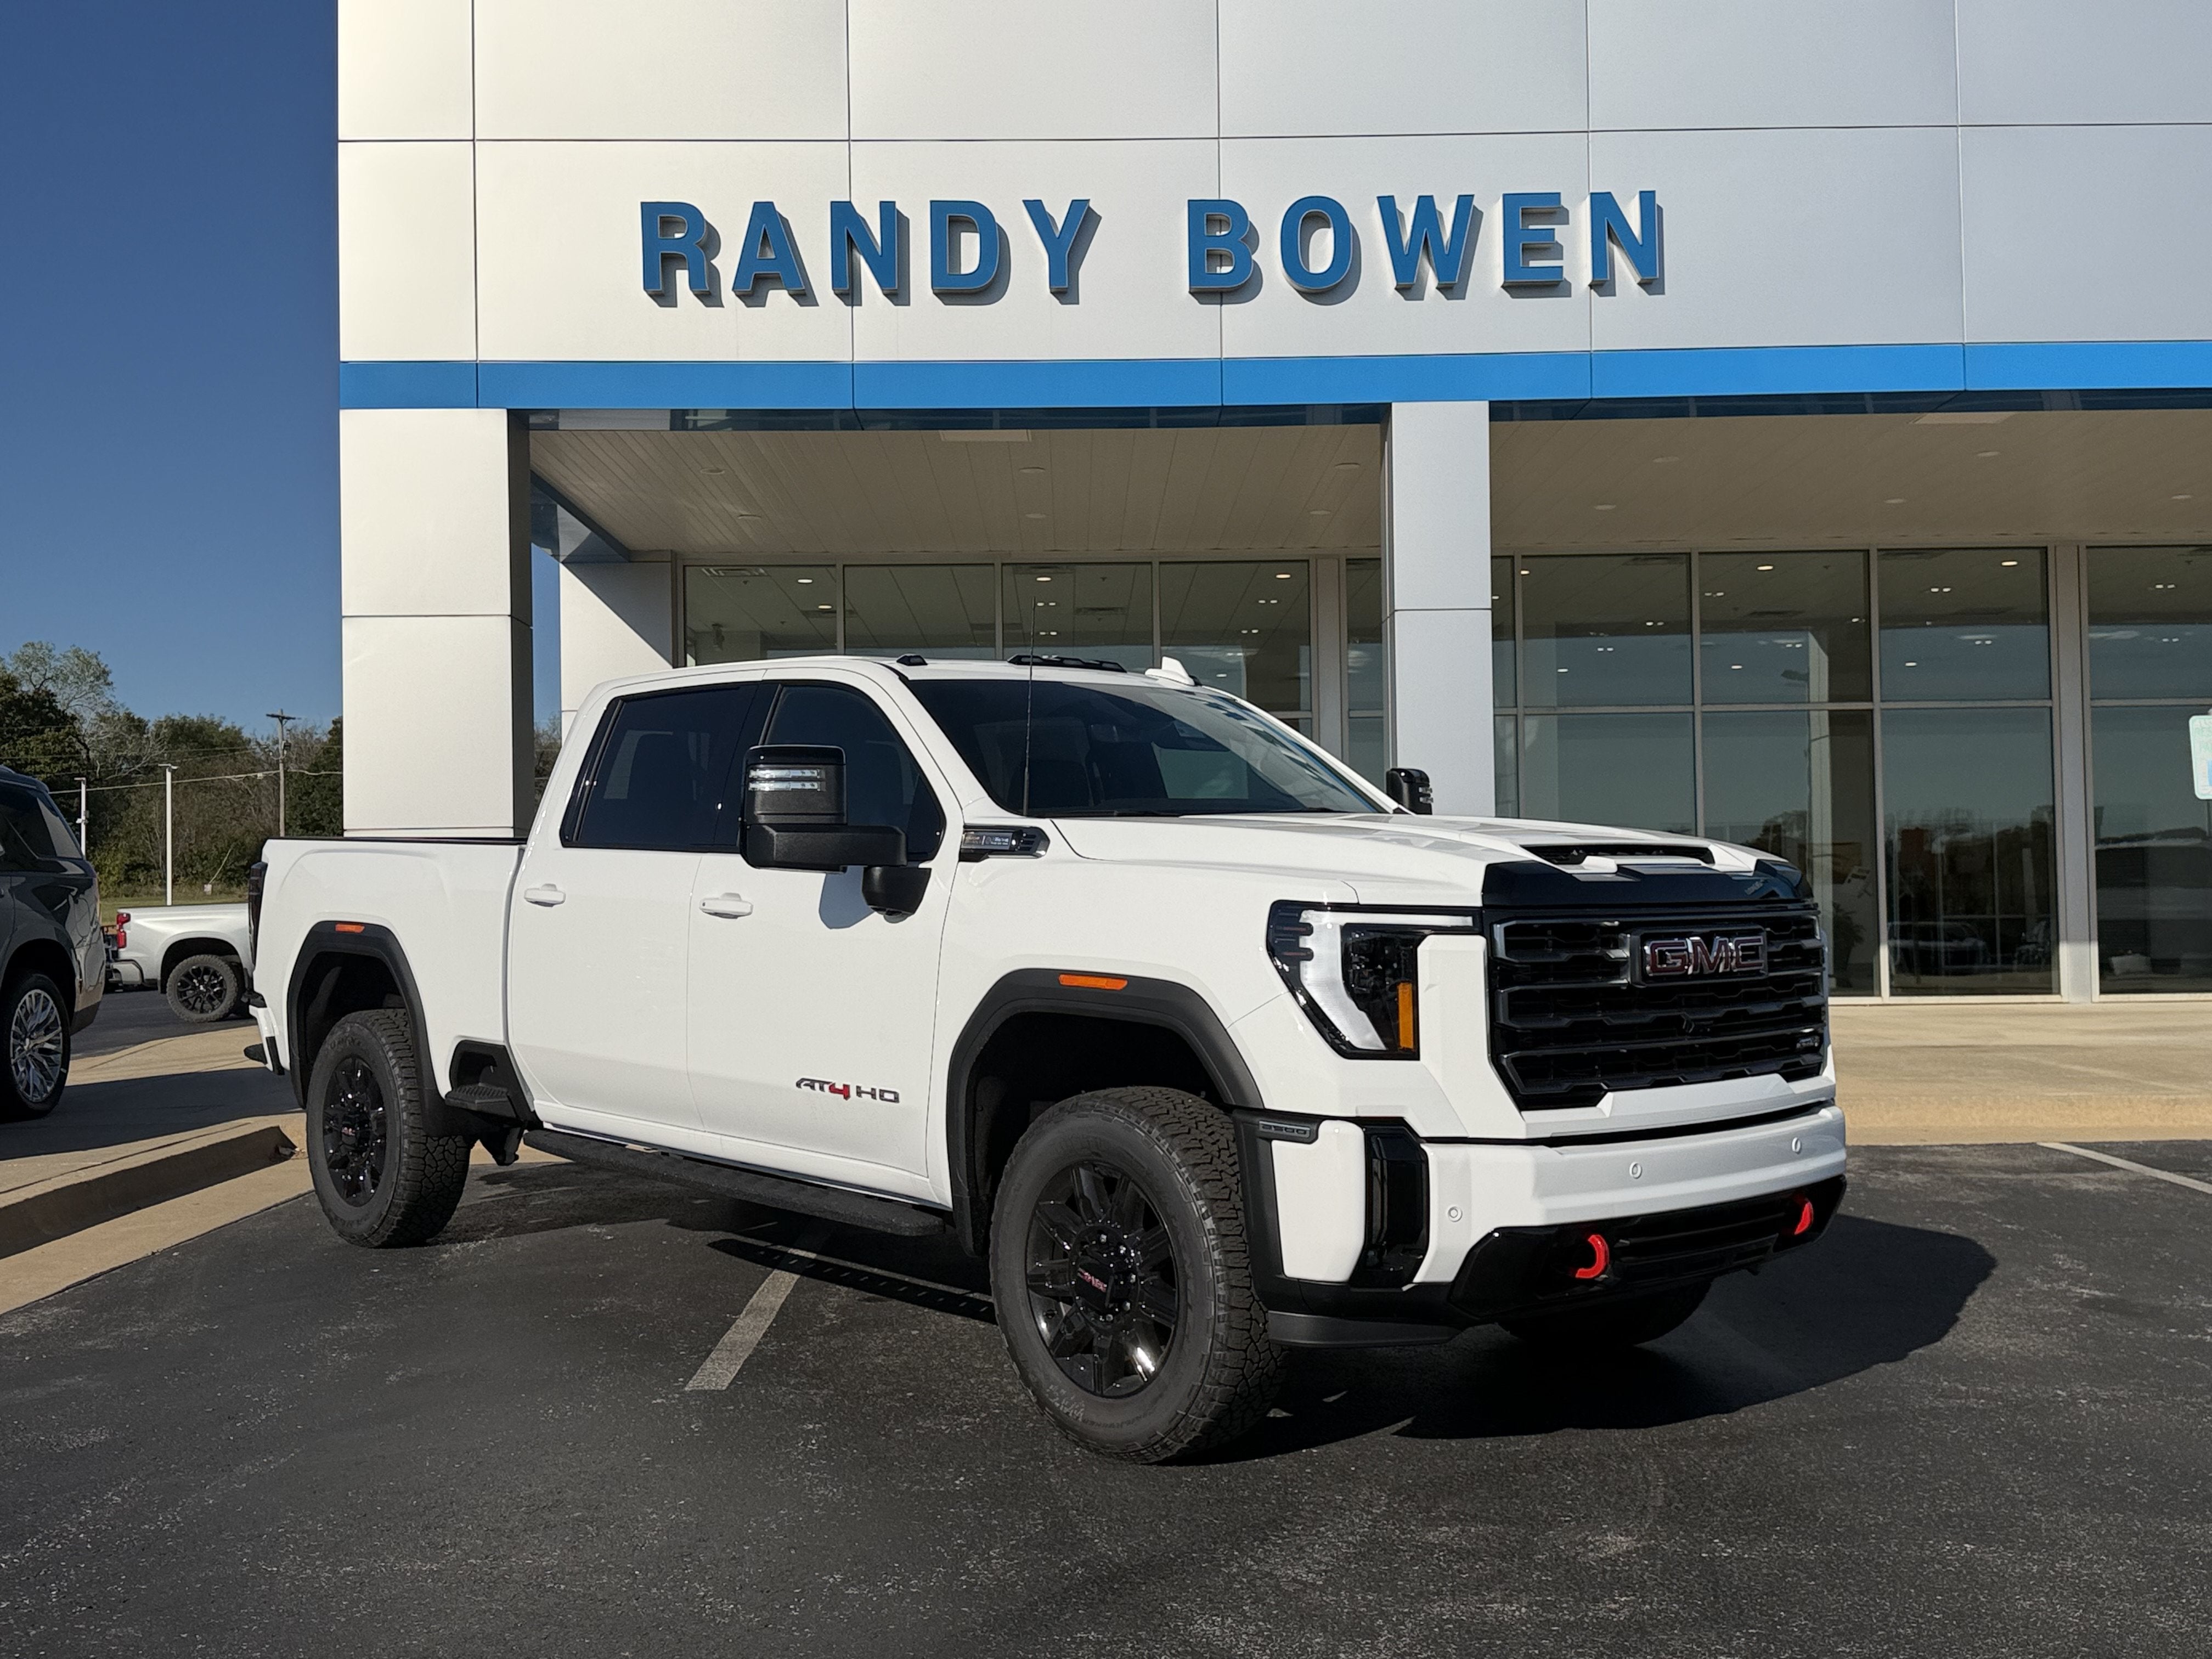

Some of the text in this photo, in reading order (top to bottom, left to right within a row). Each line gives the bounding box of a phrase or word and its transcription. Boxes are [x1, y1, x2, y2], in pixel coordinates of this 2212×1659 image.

[640, 190, 1660, 296] RANDY BOWEN
[1646, 935, 1764, 977] GMC
[796, 1077, 900, 1104] AT4 HD
